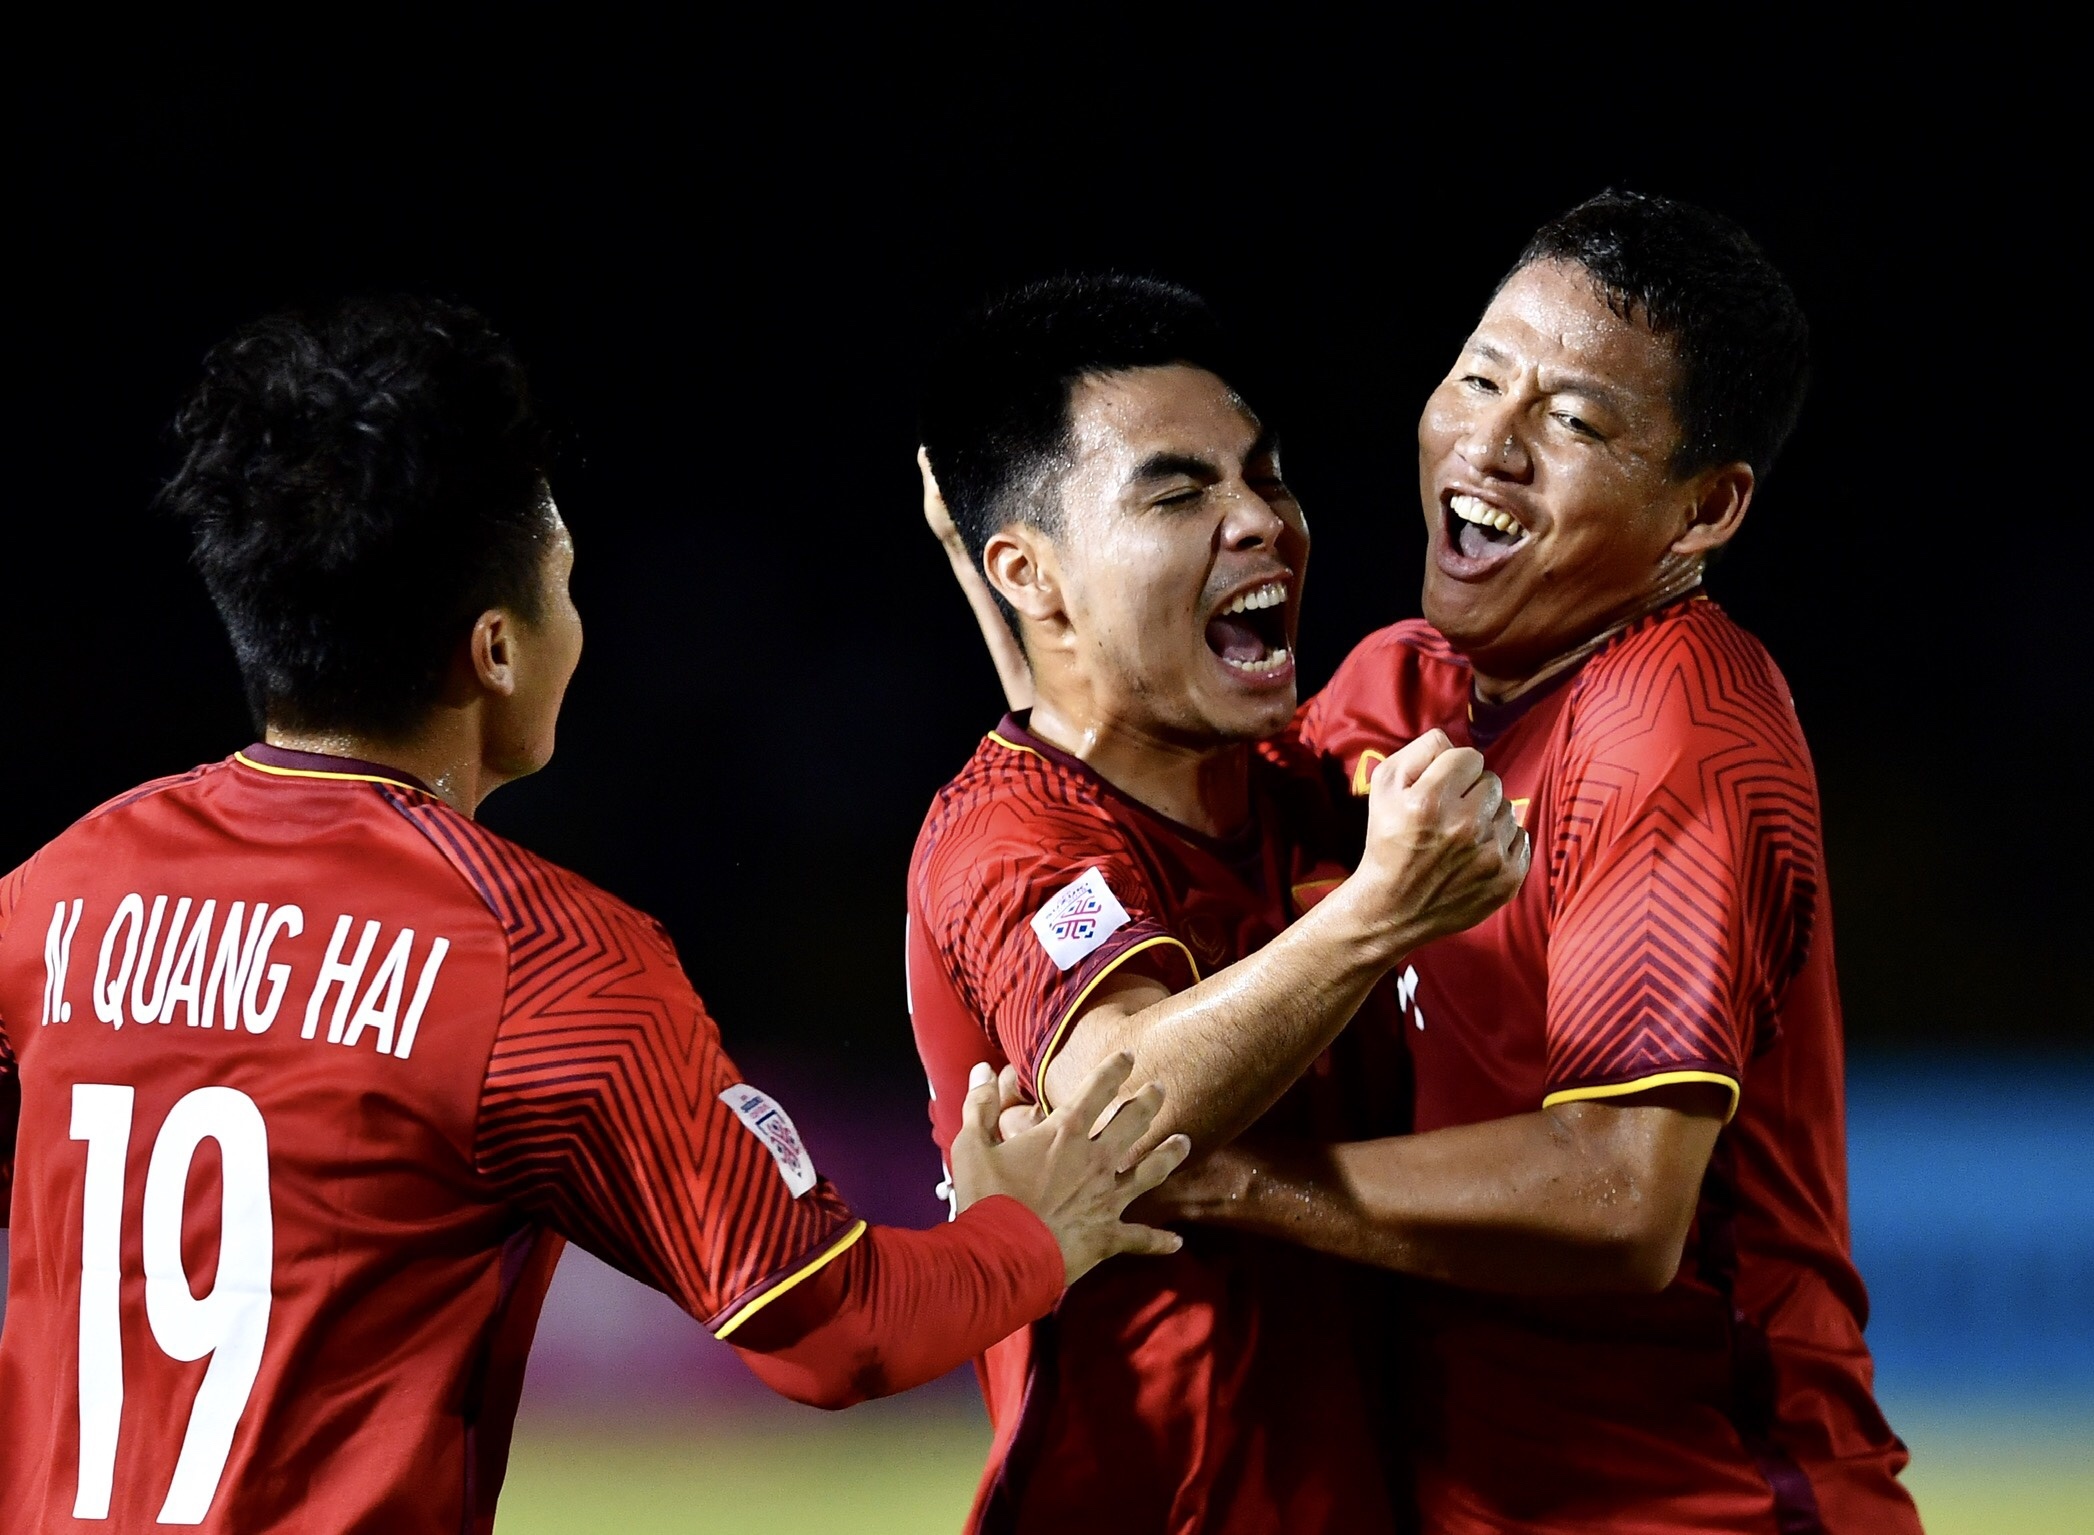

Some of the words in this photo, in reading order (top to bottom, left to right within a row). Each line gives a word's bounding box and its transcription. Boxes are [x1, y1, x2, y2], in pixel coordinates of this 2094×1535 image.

[41, 898, 84, 1027] N.
[92, 892, 304, 1034] QUANG
[300, 914, 450, 1060] HAI
[68, 1083, 274, 1525] 19
